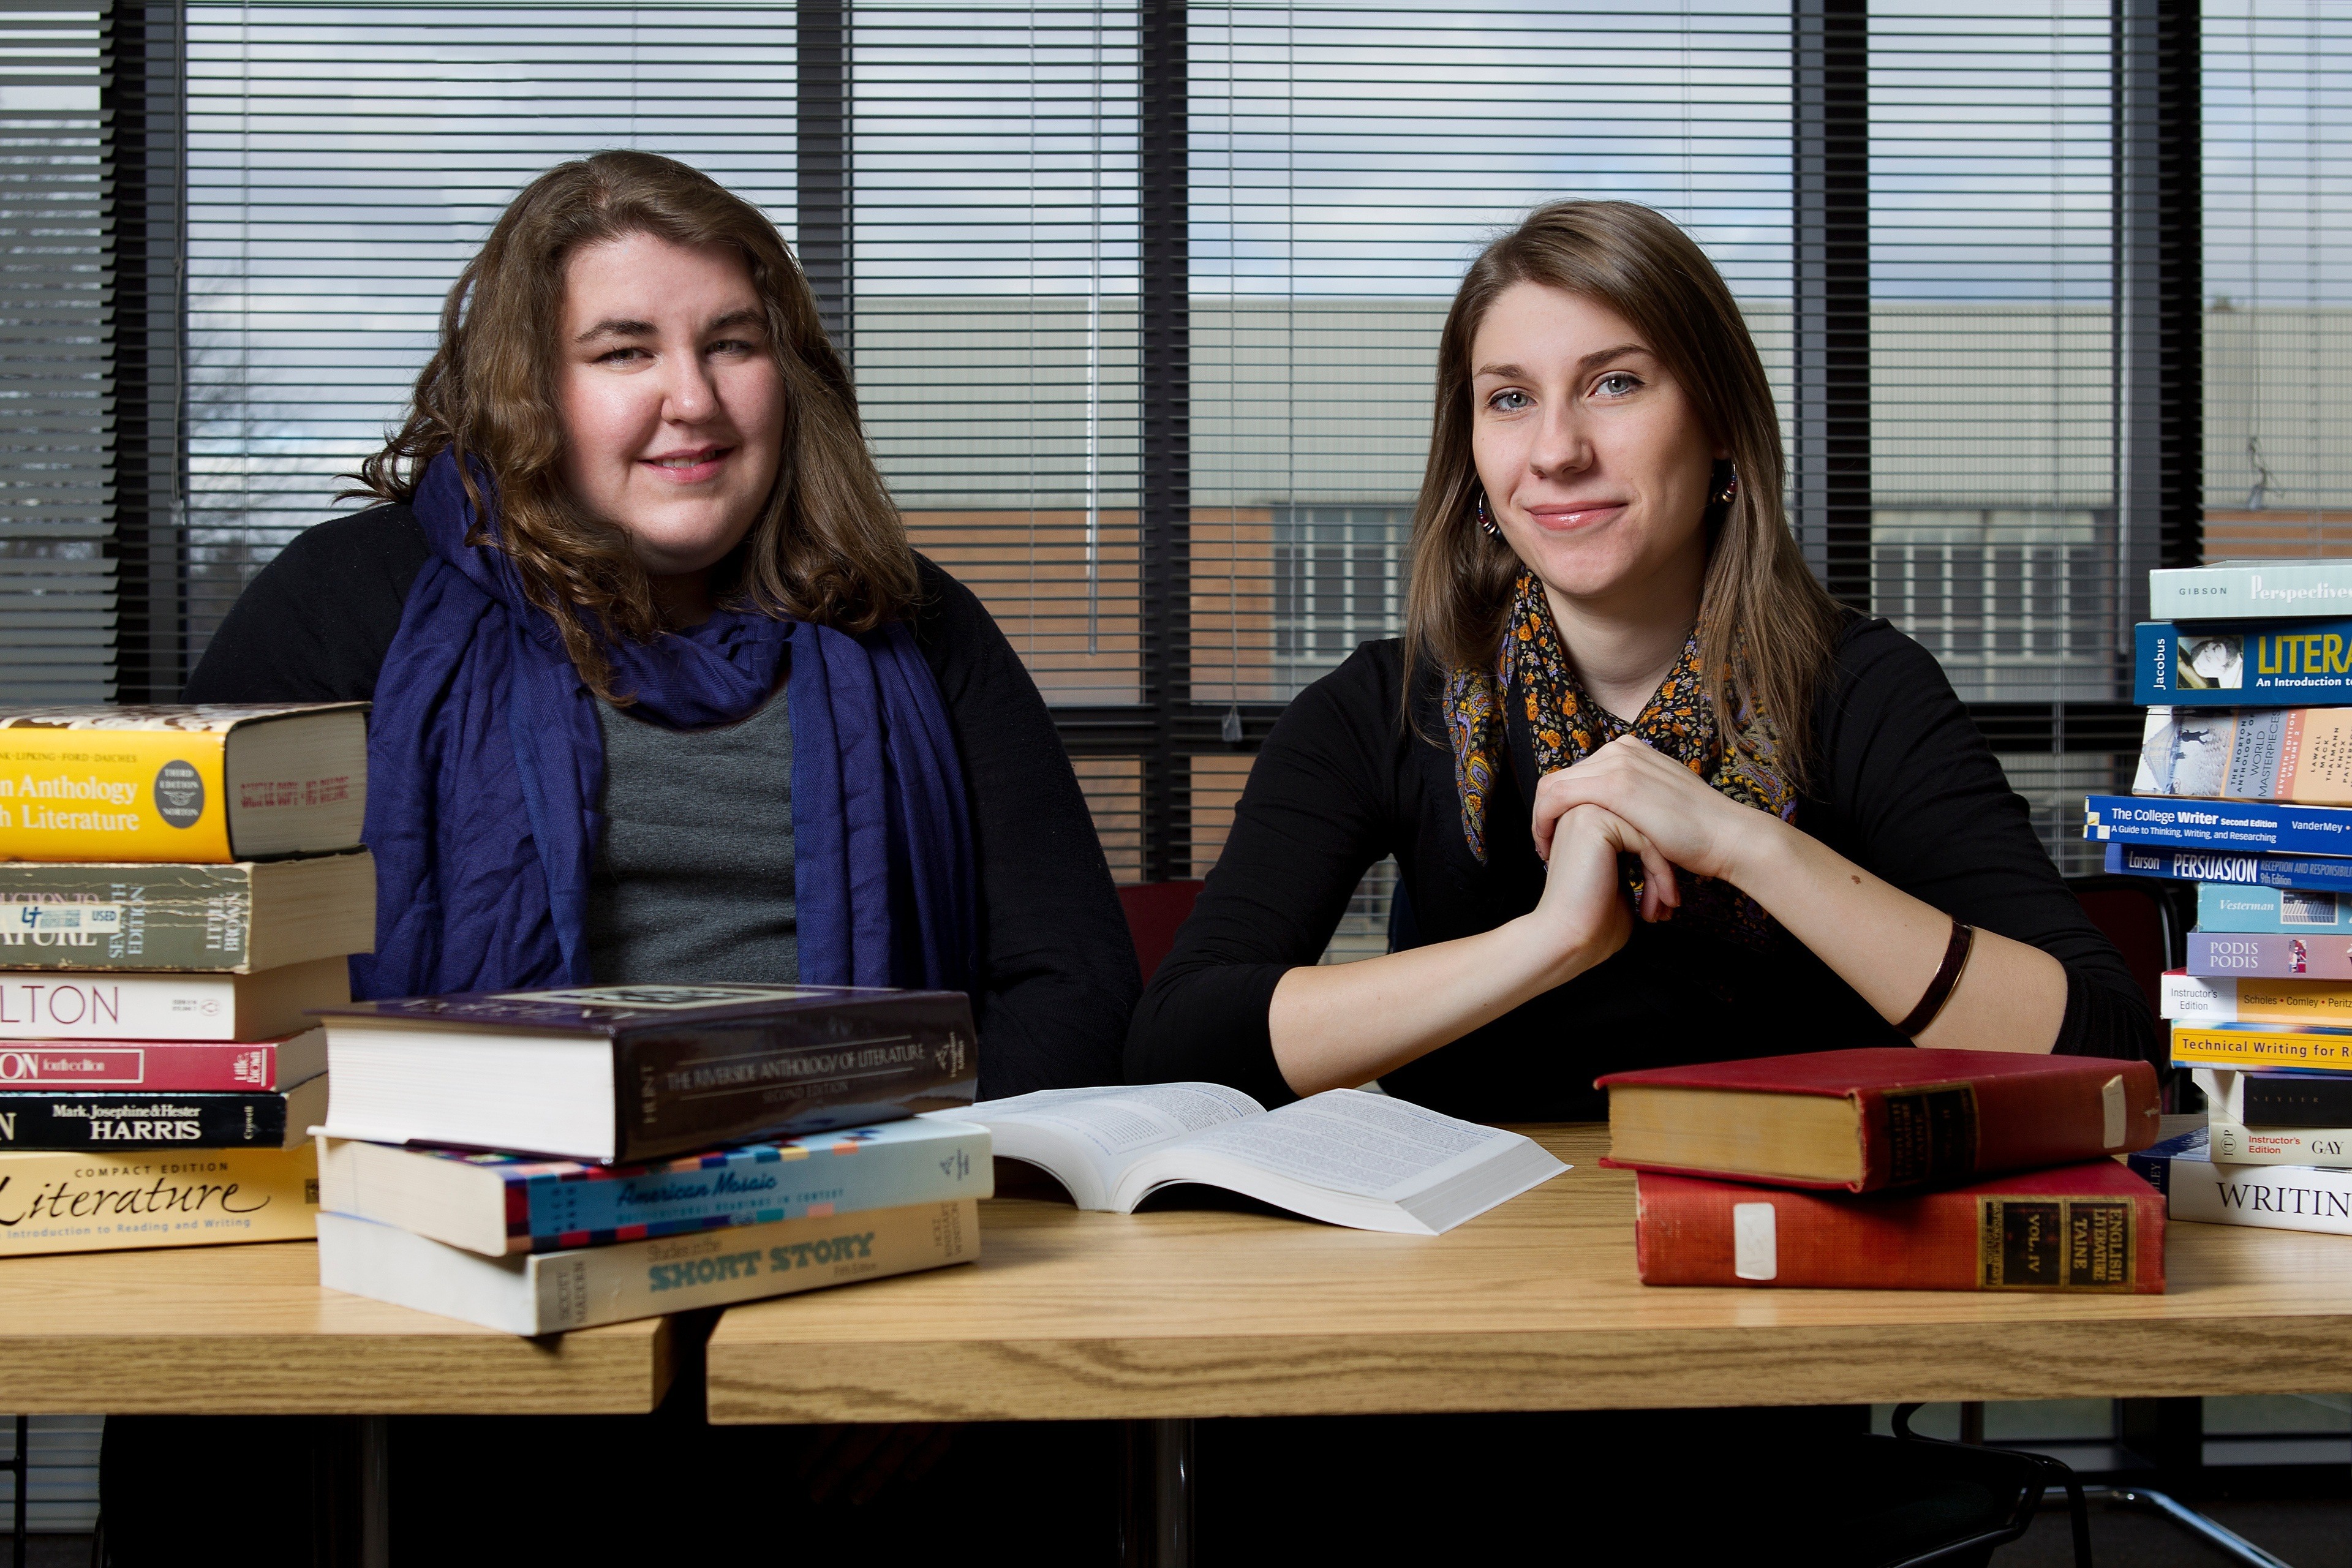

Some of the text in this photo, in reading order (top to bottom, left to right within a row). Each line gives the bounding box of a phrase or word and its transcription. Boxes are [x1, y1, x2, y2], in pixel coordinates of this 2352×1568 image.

[2179, 587, 2227, 595] GIBSON
[2153, 638, 2166, 690] Jacobus
[2256, 678, 2271, 687] An
[2275, 676, 2341, 687] Introduction
[2236, 721, 2247, 763] NORTON
[2250, 731, 2266, 776] WORLD
[2258, 710, 2280, 797] MASTERPIECES
[2278, 713, 2296, 794] SEVENTH EDITION
[2311, 735, 2321, 772] LAWALL
[2320, 740, 2329, 768] MACK
[2326, 728, 2339, 781] THALMANN
[2337, 741, 2346, 768] KNOX
[2237, 732, 2253, 793] ANTHOLOGY
[2287, 741, 2298, 777] VOLUME
[159, 780, 199, 789] EDITION
[165, 768, 194, 778] THIRD
[18, 775, 138, 805] Anthology
[22, 805, 140, 831] Literature
[163, 807, 199, 816] NORTON
[2111, 808, 2343, 834] The College Writer Second Edition VanderMey
[2119, 825, 2139, 835] Guide
[2150, 826, 2182, 838] Thinking,
[2184, 829, 2212, 840] Writing,
[2214, 831, 2228, 839] and
[2230, 831, 2277, 844] Researching
[2129, 851, 2160, 870] Larson
[2173, 853, 2257, 883] PERSUASION
[2261, 860, 2294, 873] RECEPTION
[2294, 862, 2309, 875] AND
[2260, 873, 2292, 886] 9th Edition
[92, 910, 116, 921] USED
[2220, 899, 2274, 911] Vesterman
[127, 886, 146, 955] EDITION
[2210, 941, 2258, 955] PODIS
[2210, 956, 2258, 968] PODIS
[2171, 988, 2218, 999] Instructor's
[2180, 1001, 2208, 1011] Edition
[2244, 995, 2352, 1008] Scholes Comley Peritz
[2182, 1038, 2248, 1053] Technical
[2253, 1042, 2307, 1058] Writing
[2314, 1044, 2335, 1057] for
[666, 1042, 926, 1091] THE RIVERSIDE ANTHOLOGY OF LITERATURE
[89, 1104, 150, 1120] Josephine
[160, 1104, 202, 1117] Hester
[89, 1121, 202, 1140] HARRIS
[2249, 1135, 2301, 1145] Instructor's
[2312, 1140, 2345, 1155] GAY
[75, 1162, 228, 1178] COMPACT EDITION
[0, 1176, 271, 1226] Literature
[617, 1169, 778, 1207] American Mosaic
[2216, 1182, 2352, 1219] WRITIN
[7, 1218, 251, 1239] Introduction to Reading and Writing
[647, 1243, 688, 1263] Studies
[702, 1236, 723, 1253] the
[2028, 1214, 2040, 1273] VOL. IV
[2073, 1217, 2089, 1269] TAINE
[2092, 1208, 2108, 1281] LITERATURE
[2108, 1208, 2123, 1281] ENGLISH
[648, 1232, 876, 1292] SHORT STORY
